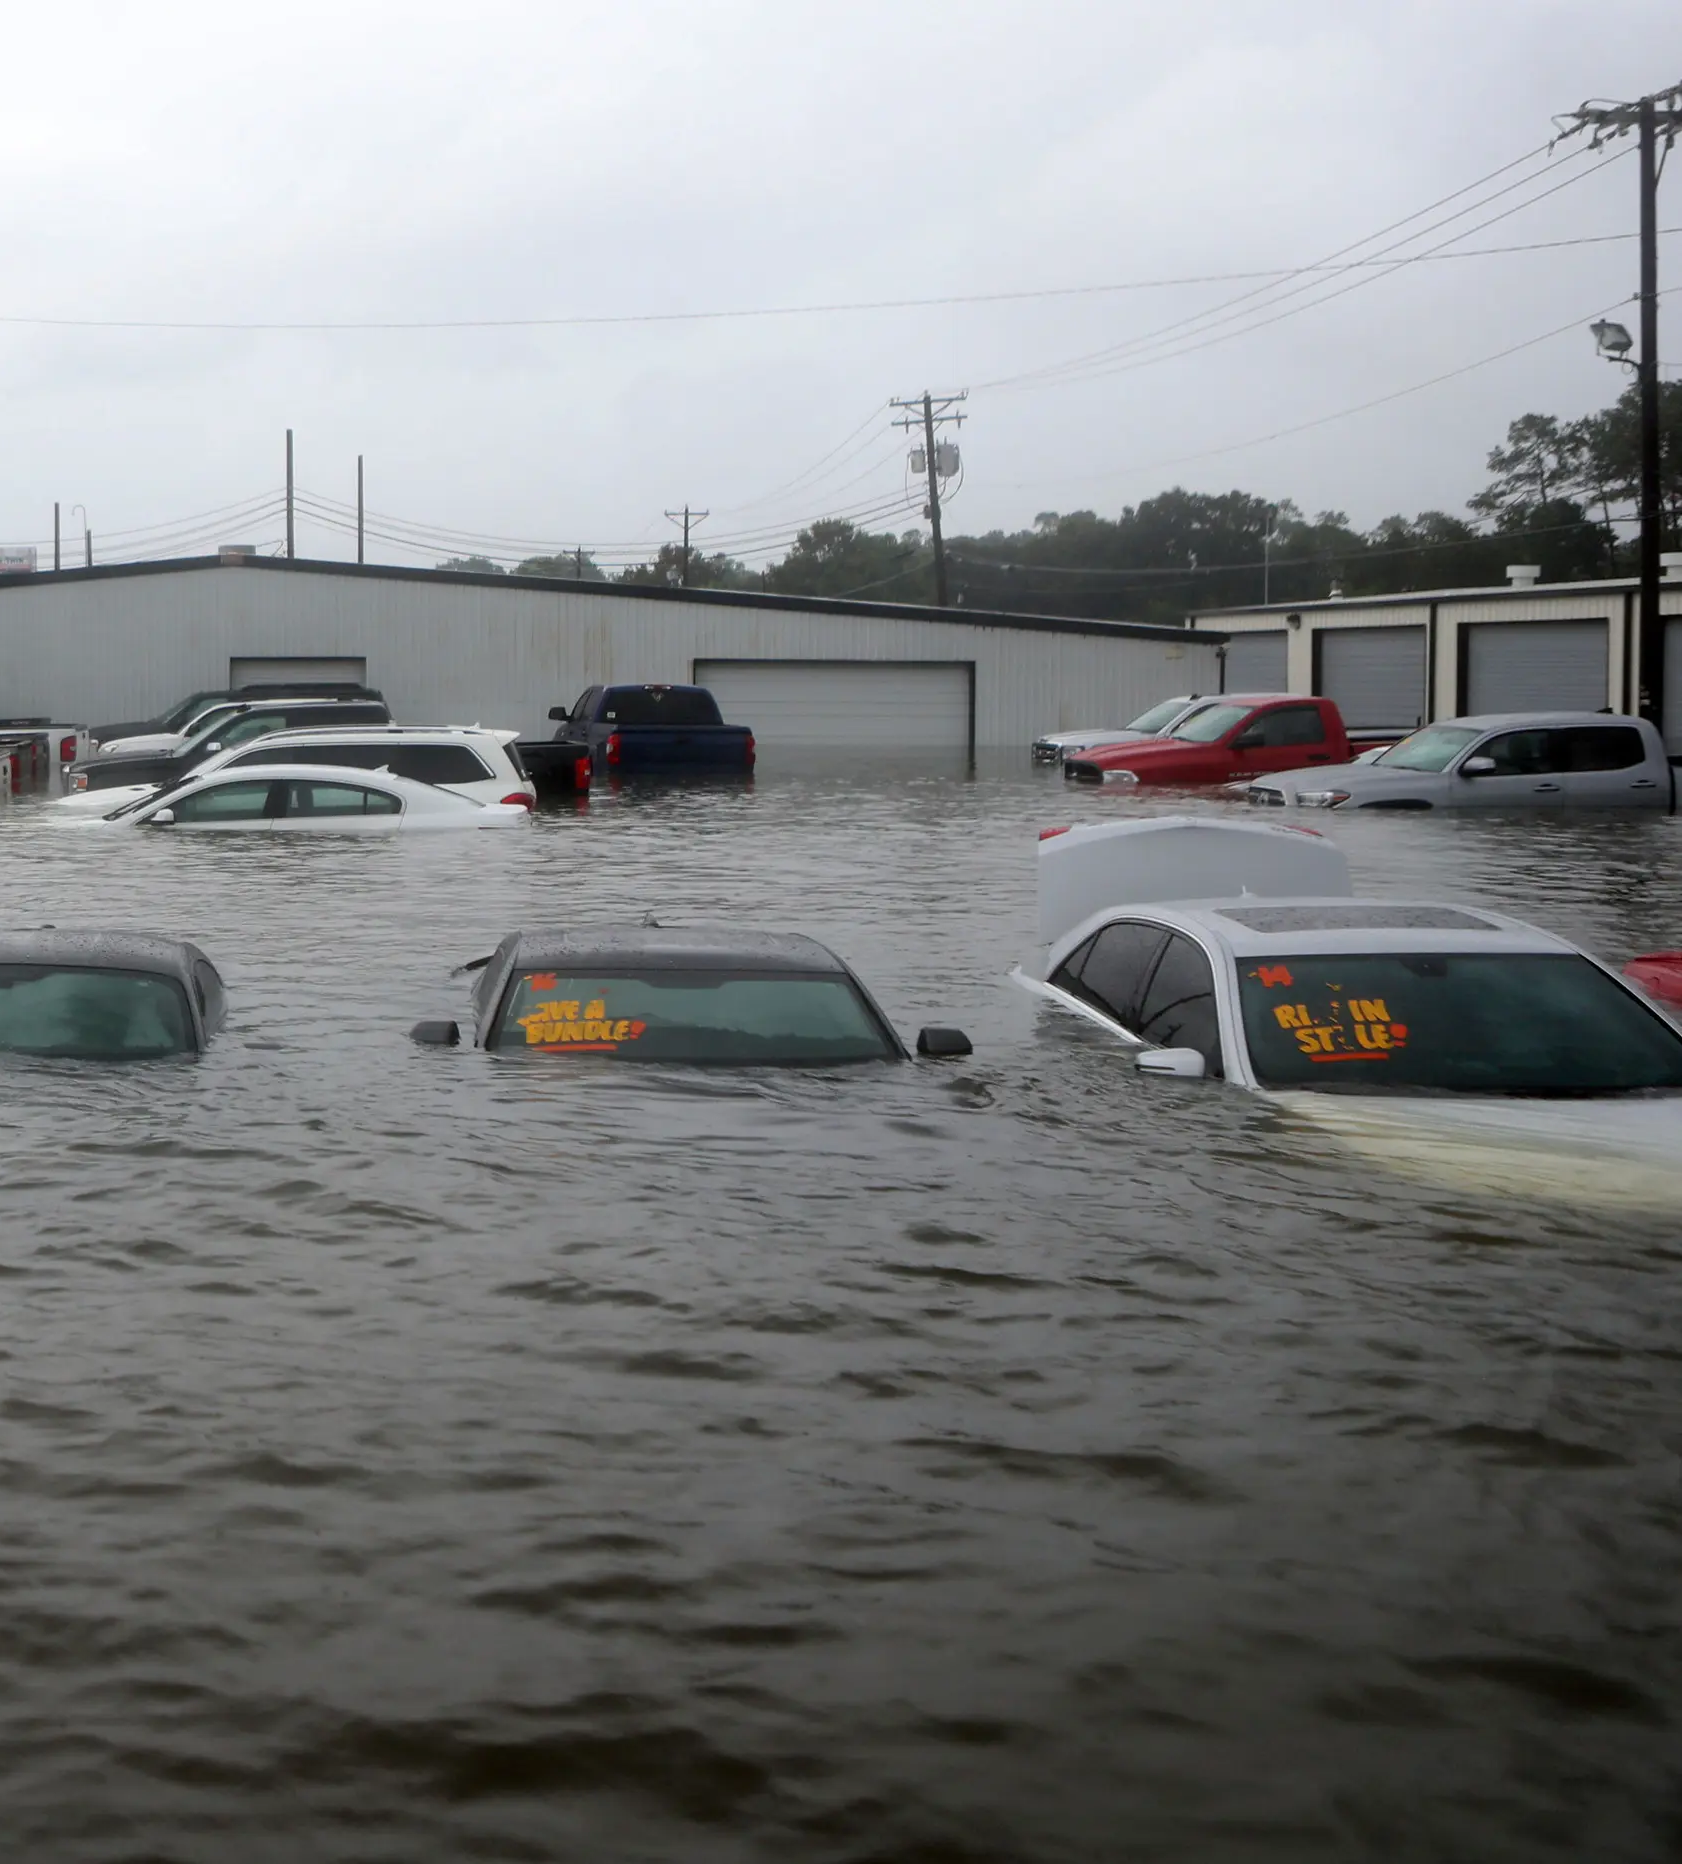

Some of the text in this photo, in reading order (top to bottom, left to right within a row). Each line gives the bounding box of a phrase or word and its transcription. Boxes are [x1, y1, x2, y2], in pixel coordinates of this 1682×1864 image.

[584, 998, 605, 1020] A
[1347, 998, 1391, 1022] IN
[1294, 1023, 1408, 1054] STLE!
